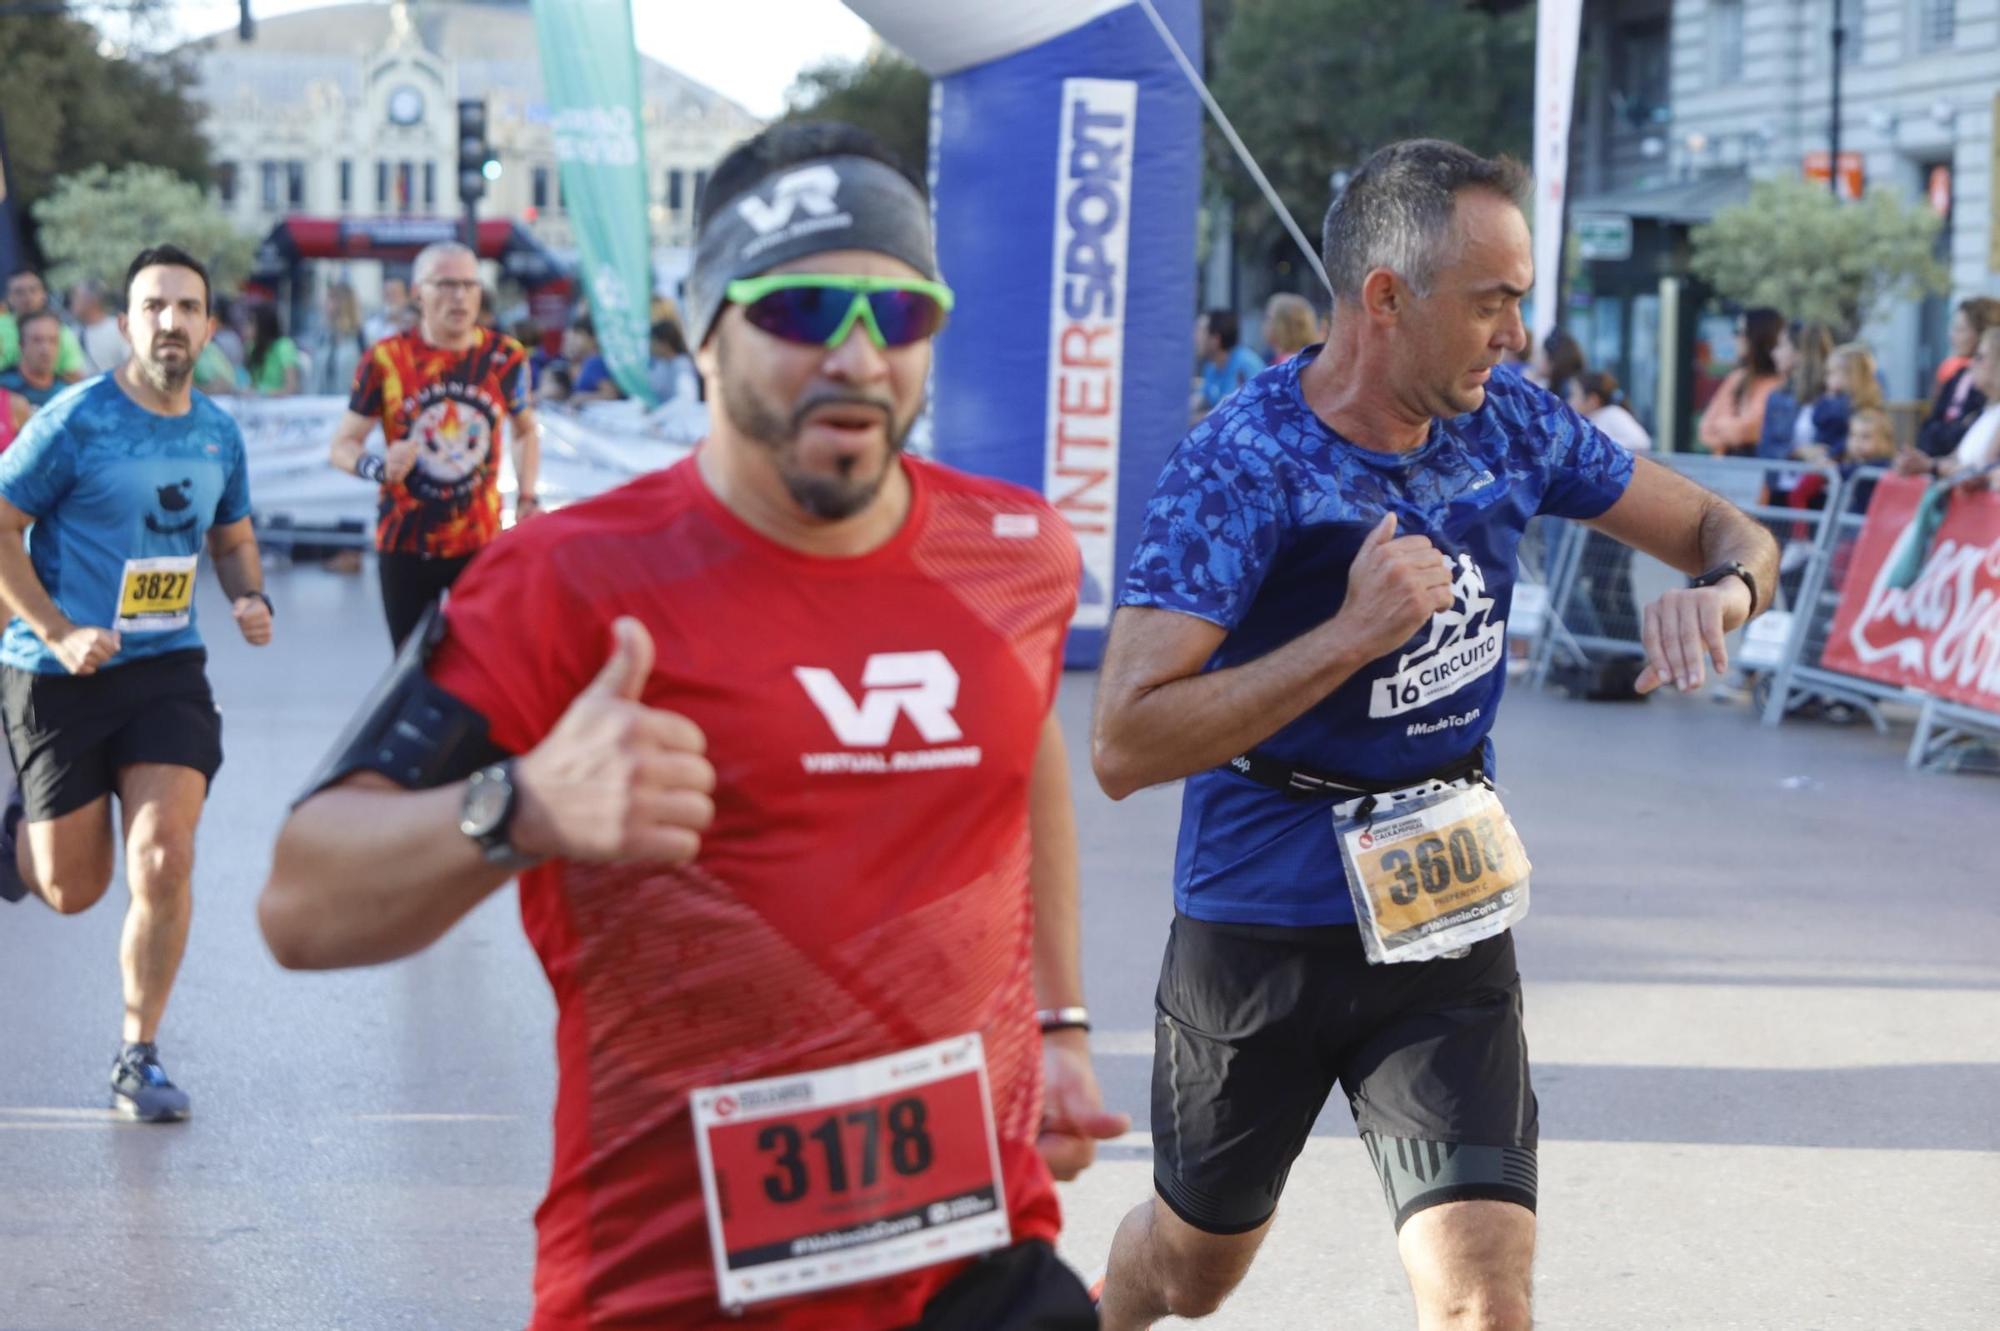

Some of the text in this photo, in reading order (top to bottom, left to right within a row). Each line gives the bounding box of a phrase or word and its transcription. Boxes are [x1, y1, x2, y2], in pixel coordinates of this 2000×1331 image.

[738, 164, 841, 233] VR
[1054, 98, 1127, 535] INTERSPORT
[132, 571, 190, 601] 3827
[792, 649, 964, 747] VR
[1386, 677, 1420, 710] 16
[1419, 635, 1497, 687] CIRCUITO
[801, 745, 982, 775] VIRTUAL RUNNING
[757, 1096, 934, 1205] 3178
